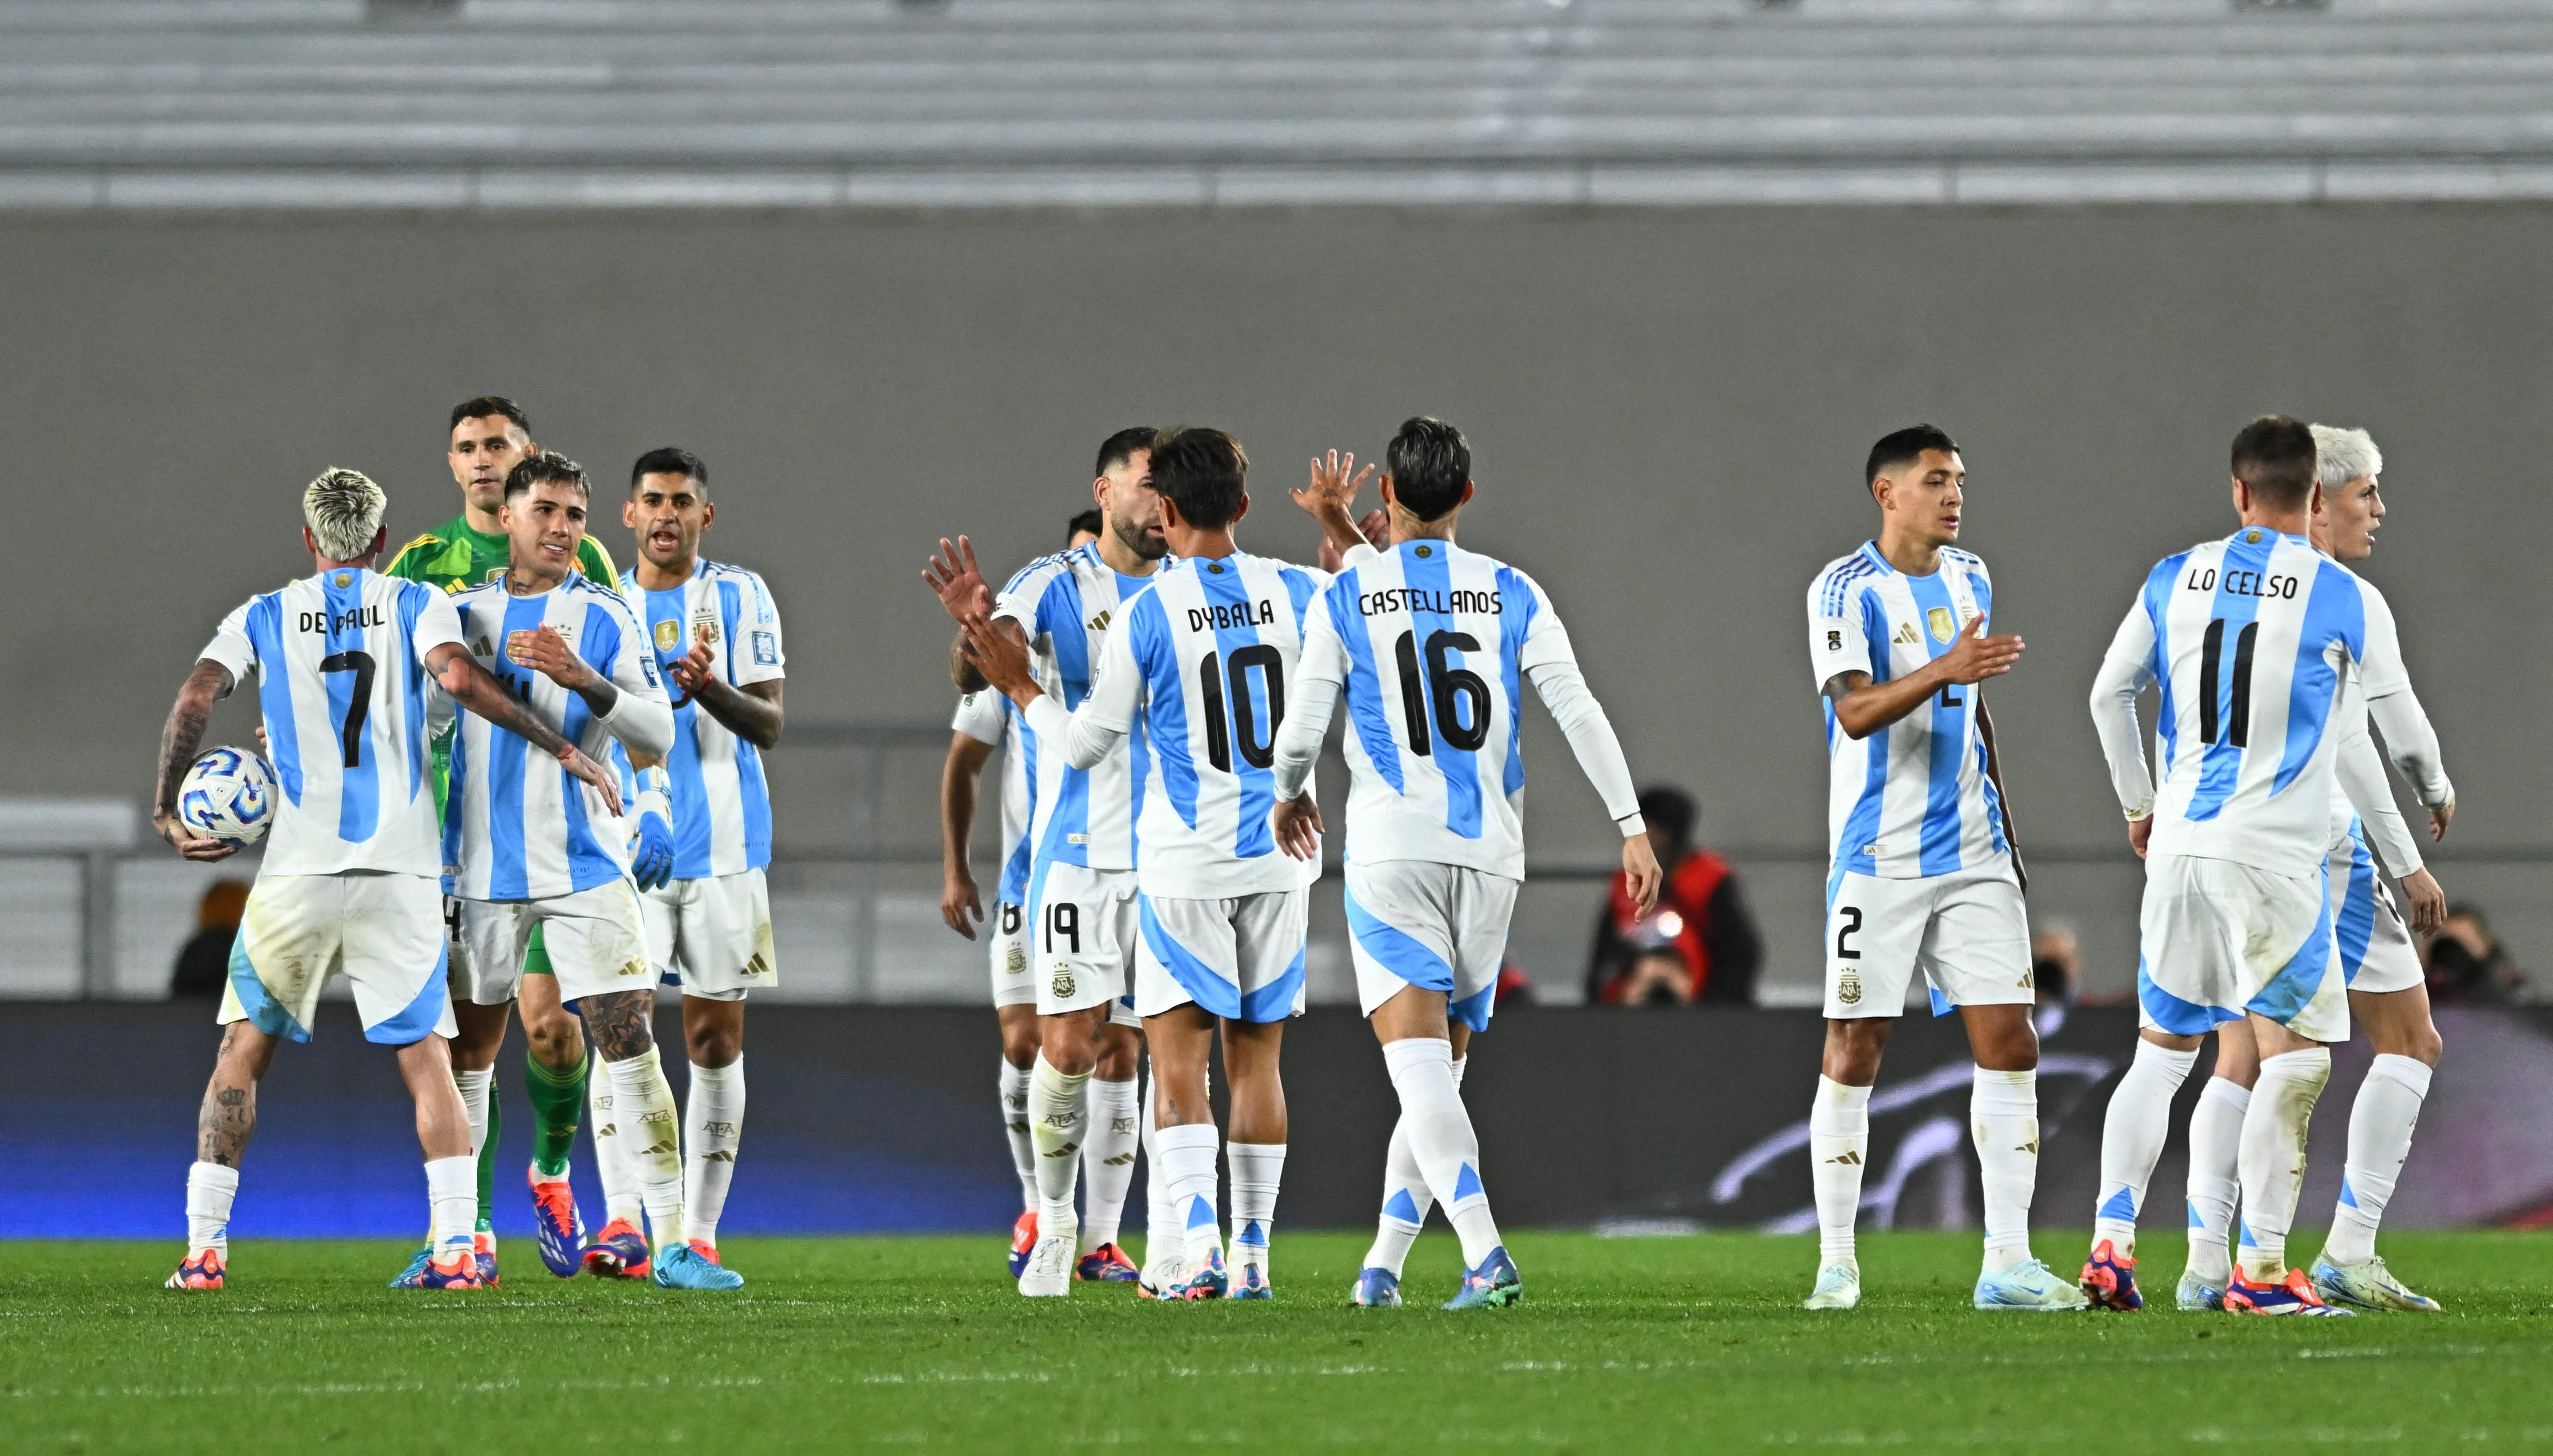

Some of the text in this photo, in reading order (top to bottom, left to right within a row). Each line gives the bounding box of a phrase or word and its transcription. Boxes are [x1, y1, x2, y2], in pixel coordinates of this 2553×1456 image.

[2188, 569, 2298, 600] LO CELSO
[1187, 599, 1274, 633] DYBALA
[1358, 589, 1503, 616] CASTELLANOS
[299, 605, 385, 636] DE PAUL
[1395, 628, 1492, 757] 16
[2199, 617, 2259, 748] 11
[318, 650, 376, 768] 7
[1200, 644, 1285, 773] 10
[1003, 902, 1021, 935] 8
[1046, 903, 1080, 954] 19
[1838, 907, 1862, 959] 2
[1056, 977, 1070, 991] AFA
[1841, 982, 1856, 996] AFA
[636, 1110, 673, 1124] AFA
[702, 1121, 735, 1137] AFA
[1044, 1112, 1078, 1128] AFA
